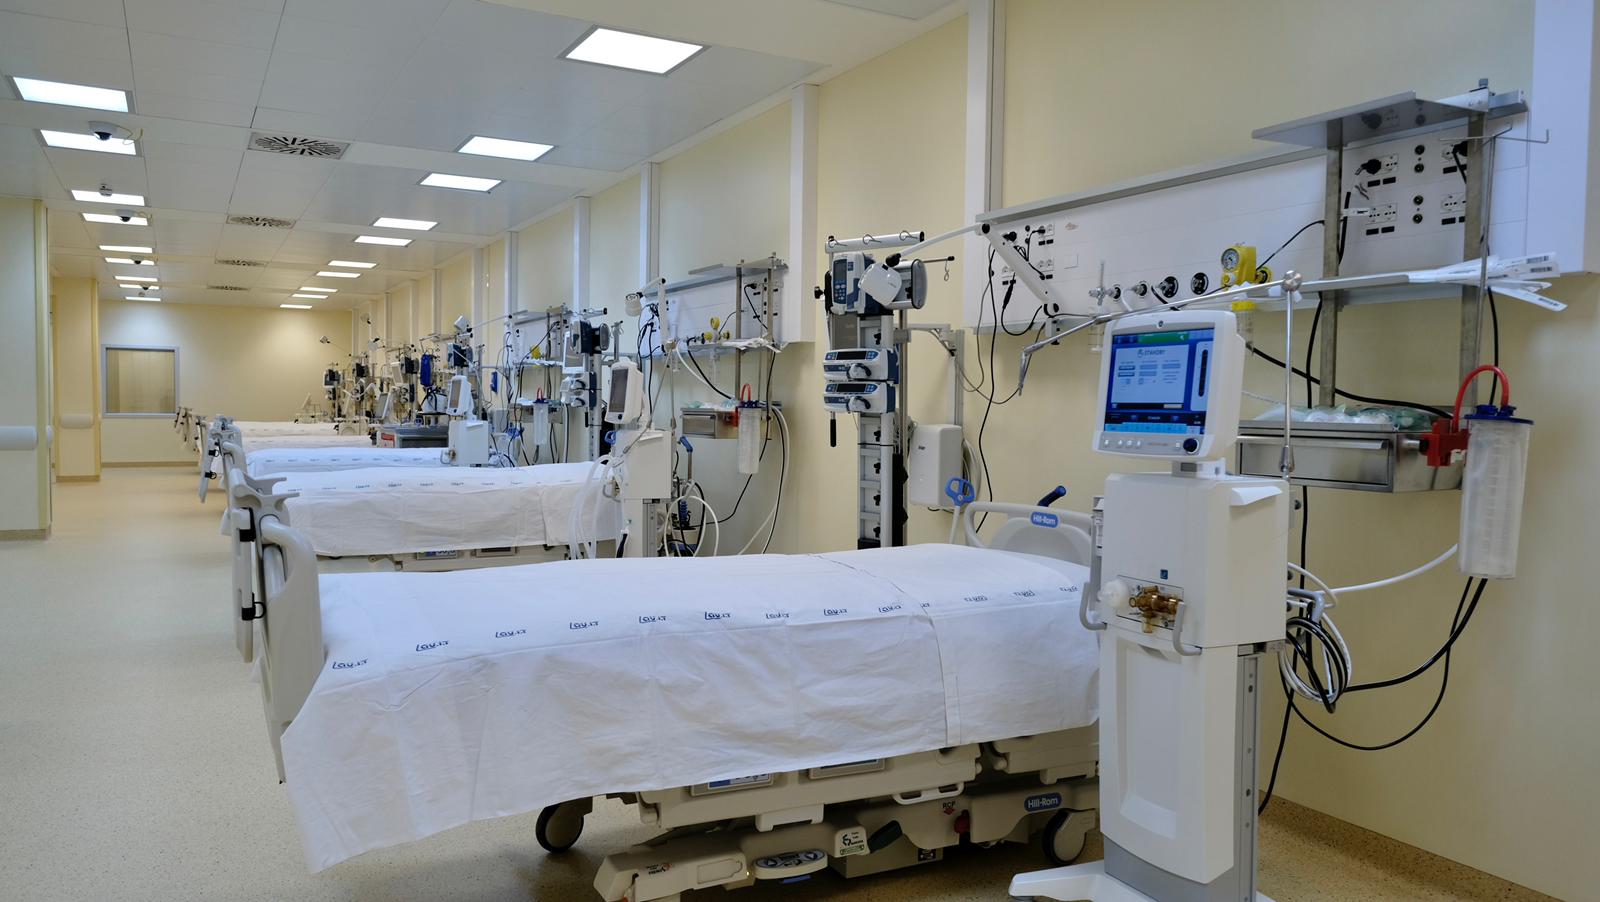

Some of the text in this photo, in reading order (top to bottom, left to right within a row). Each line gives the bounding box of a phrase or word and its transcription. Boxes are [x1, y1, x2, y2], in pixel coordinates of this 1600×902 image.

[1033, 514, 1056, 526] Hill-Rom
[942, 801, 956, 809] RCP
[1027, 796, 1059, 809] Hill-Rom
